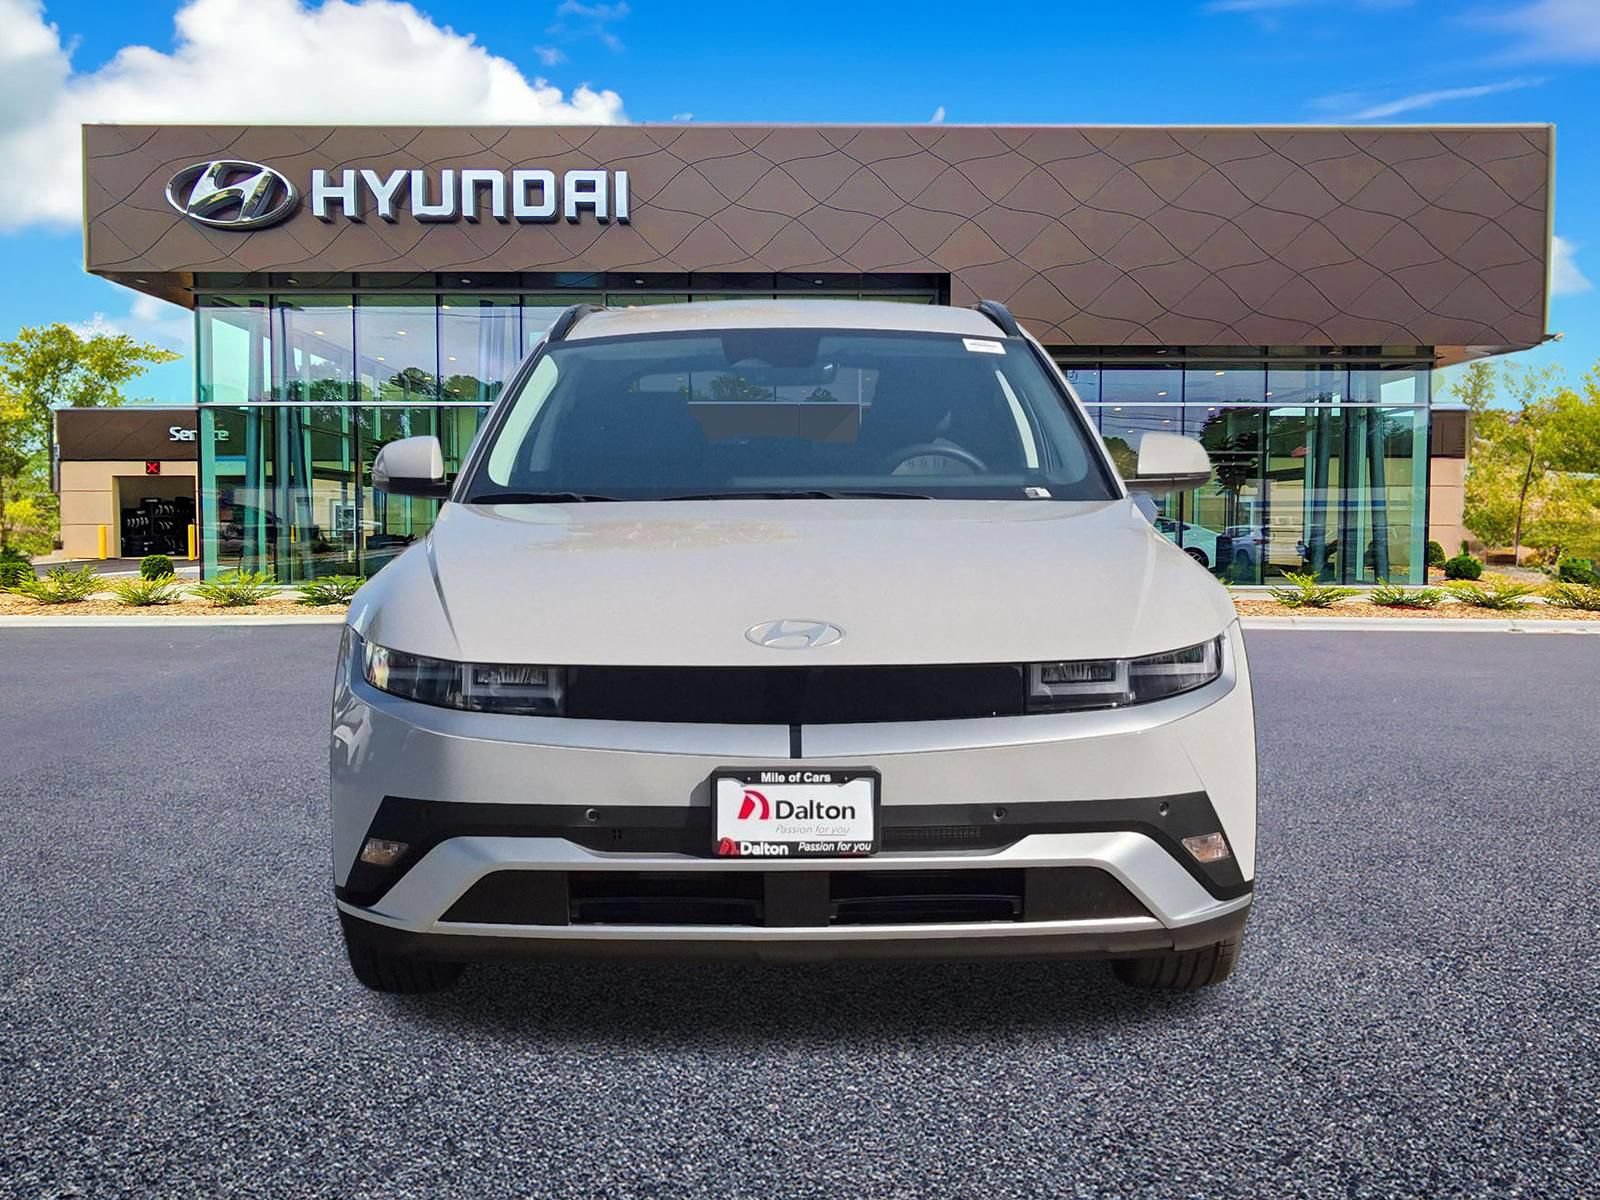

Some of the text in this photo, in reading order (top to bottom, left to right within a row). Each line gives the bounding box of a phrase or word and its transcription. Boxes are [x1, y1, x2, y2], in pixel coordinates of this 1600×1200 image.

[312, 169, 630, 222] HYUNDAI
[760, 772, 832, 783] Mile of Cars
[775, 799, 856, 820] Dalton
[775, 823, 850, 836] Passion for you
[739, 841, 790, 856] Dalton
[797, 841, 872, 854] Passion for you
